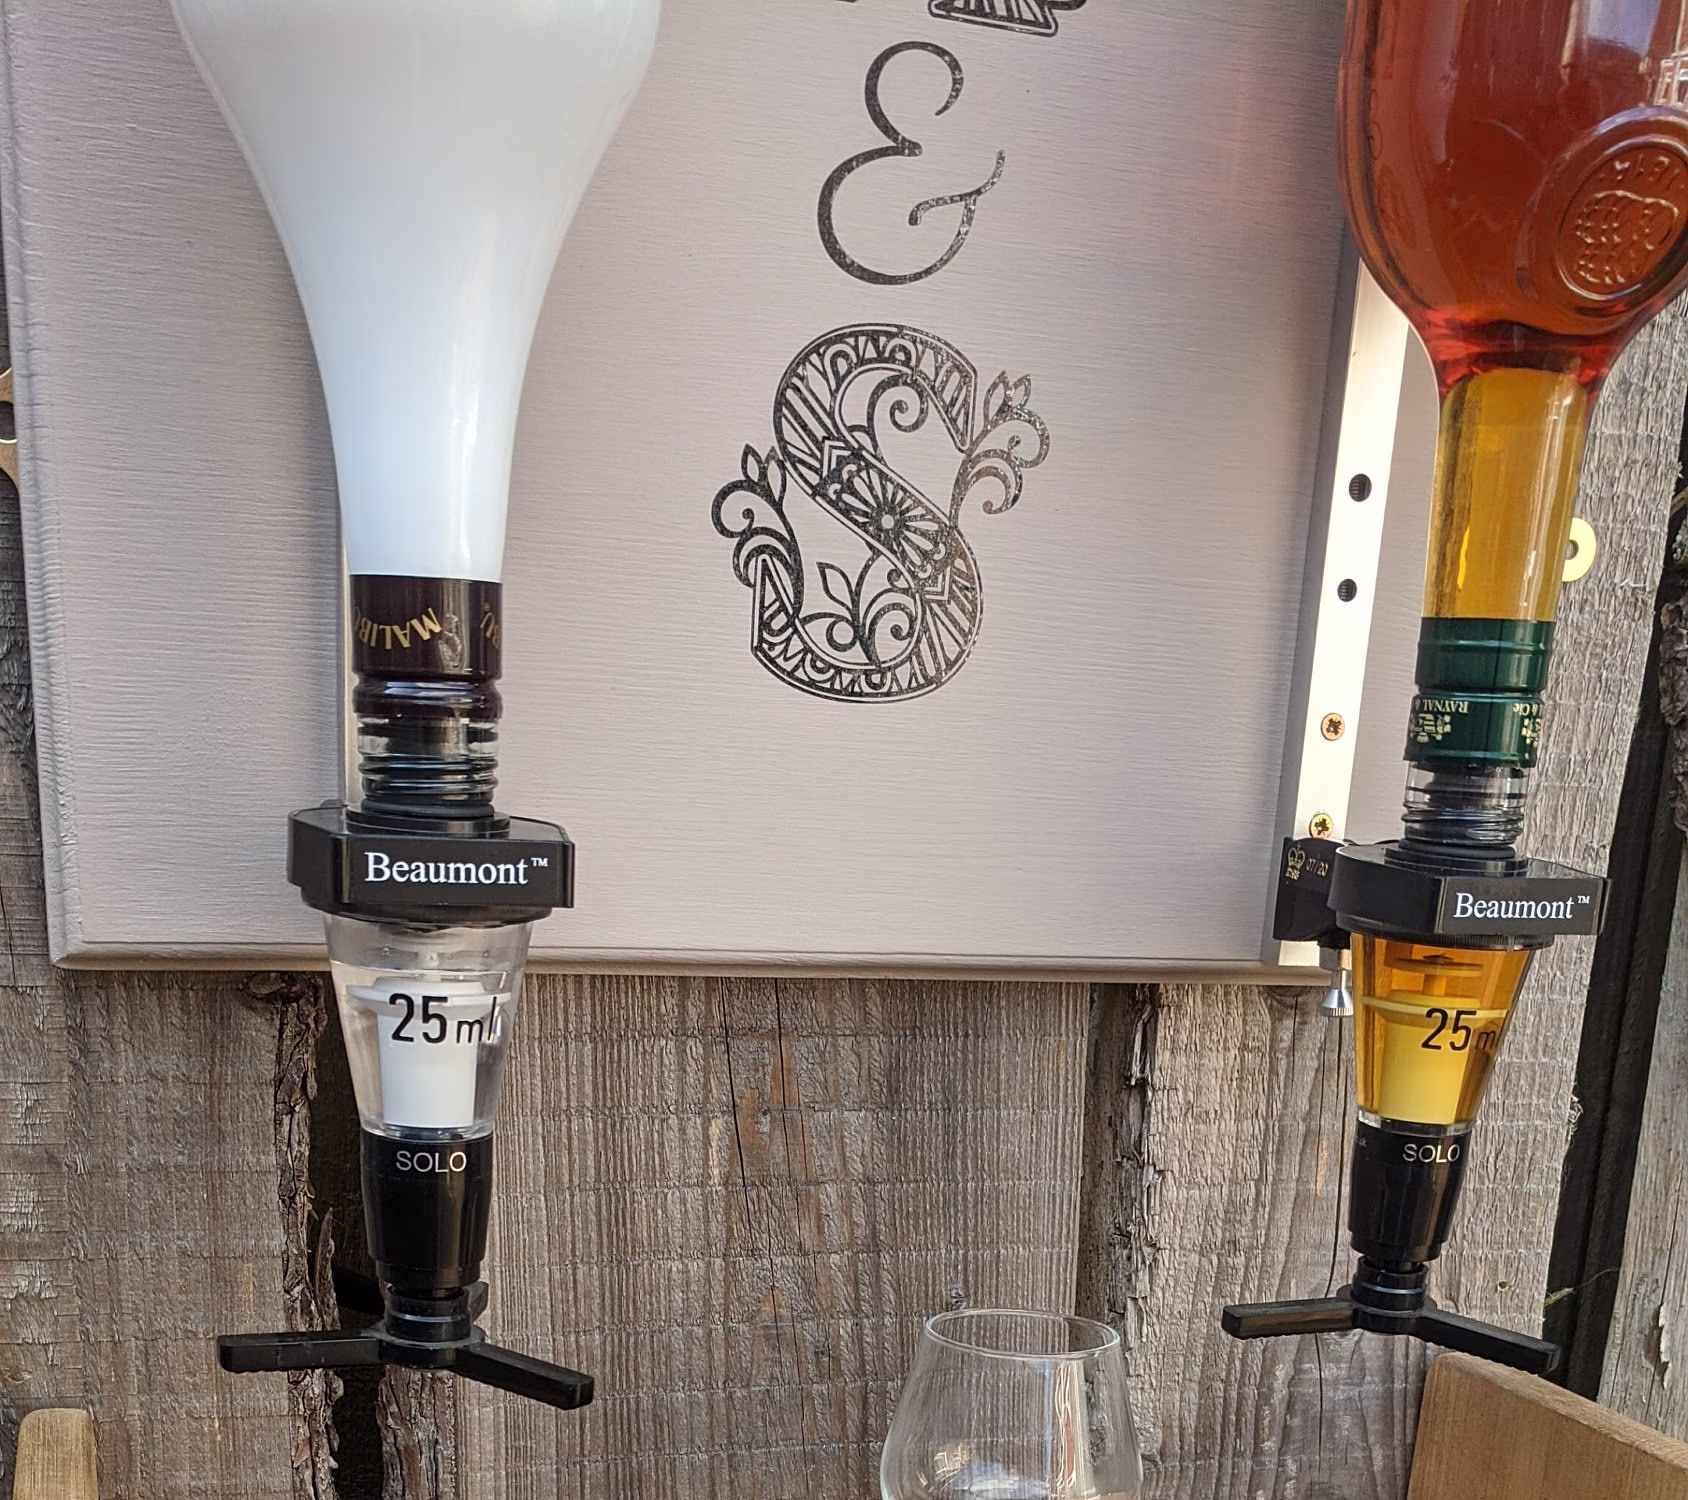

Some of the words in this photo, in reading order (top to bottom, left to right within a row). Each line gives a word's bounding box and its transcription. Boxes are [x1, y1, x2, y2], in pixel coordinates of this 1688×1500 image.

[817, 41, 1006, 285] &
[745, 323, 990, 703] S
[1423, 700, 1469, 714] RAYNAL
[396, 1151, 467, 1173] SOLO
[1402, 1143, 1460, 1163] SOLO
